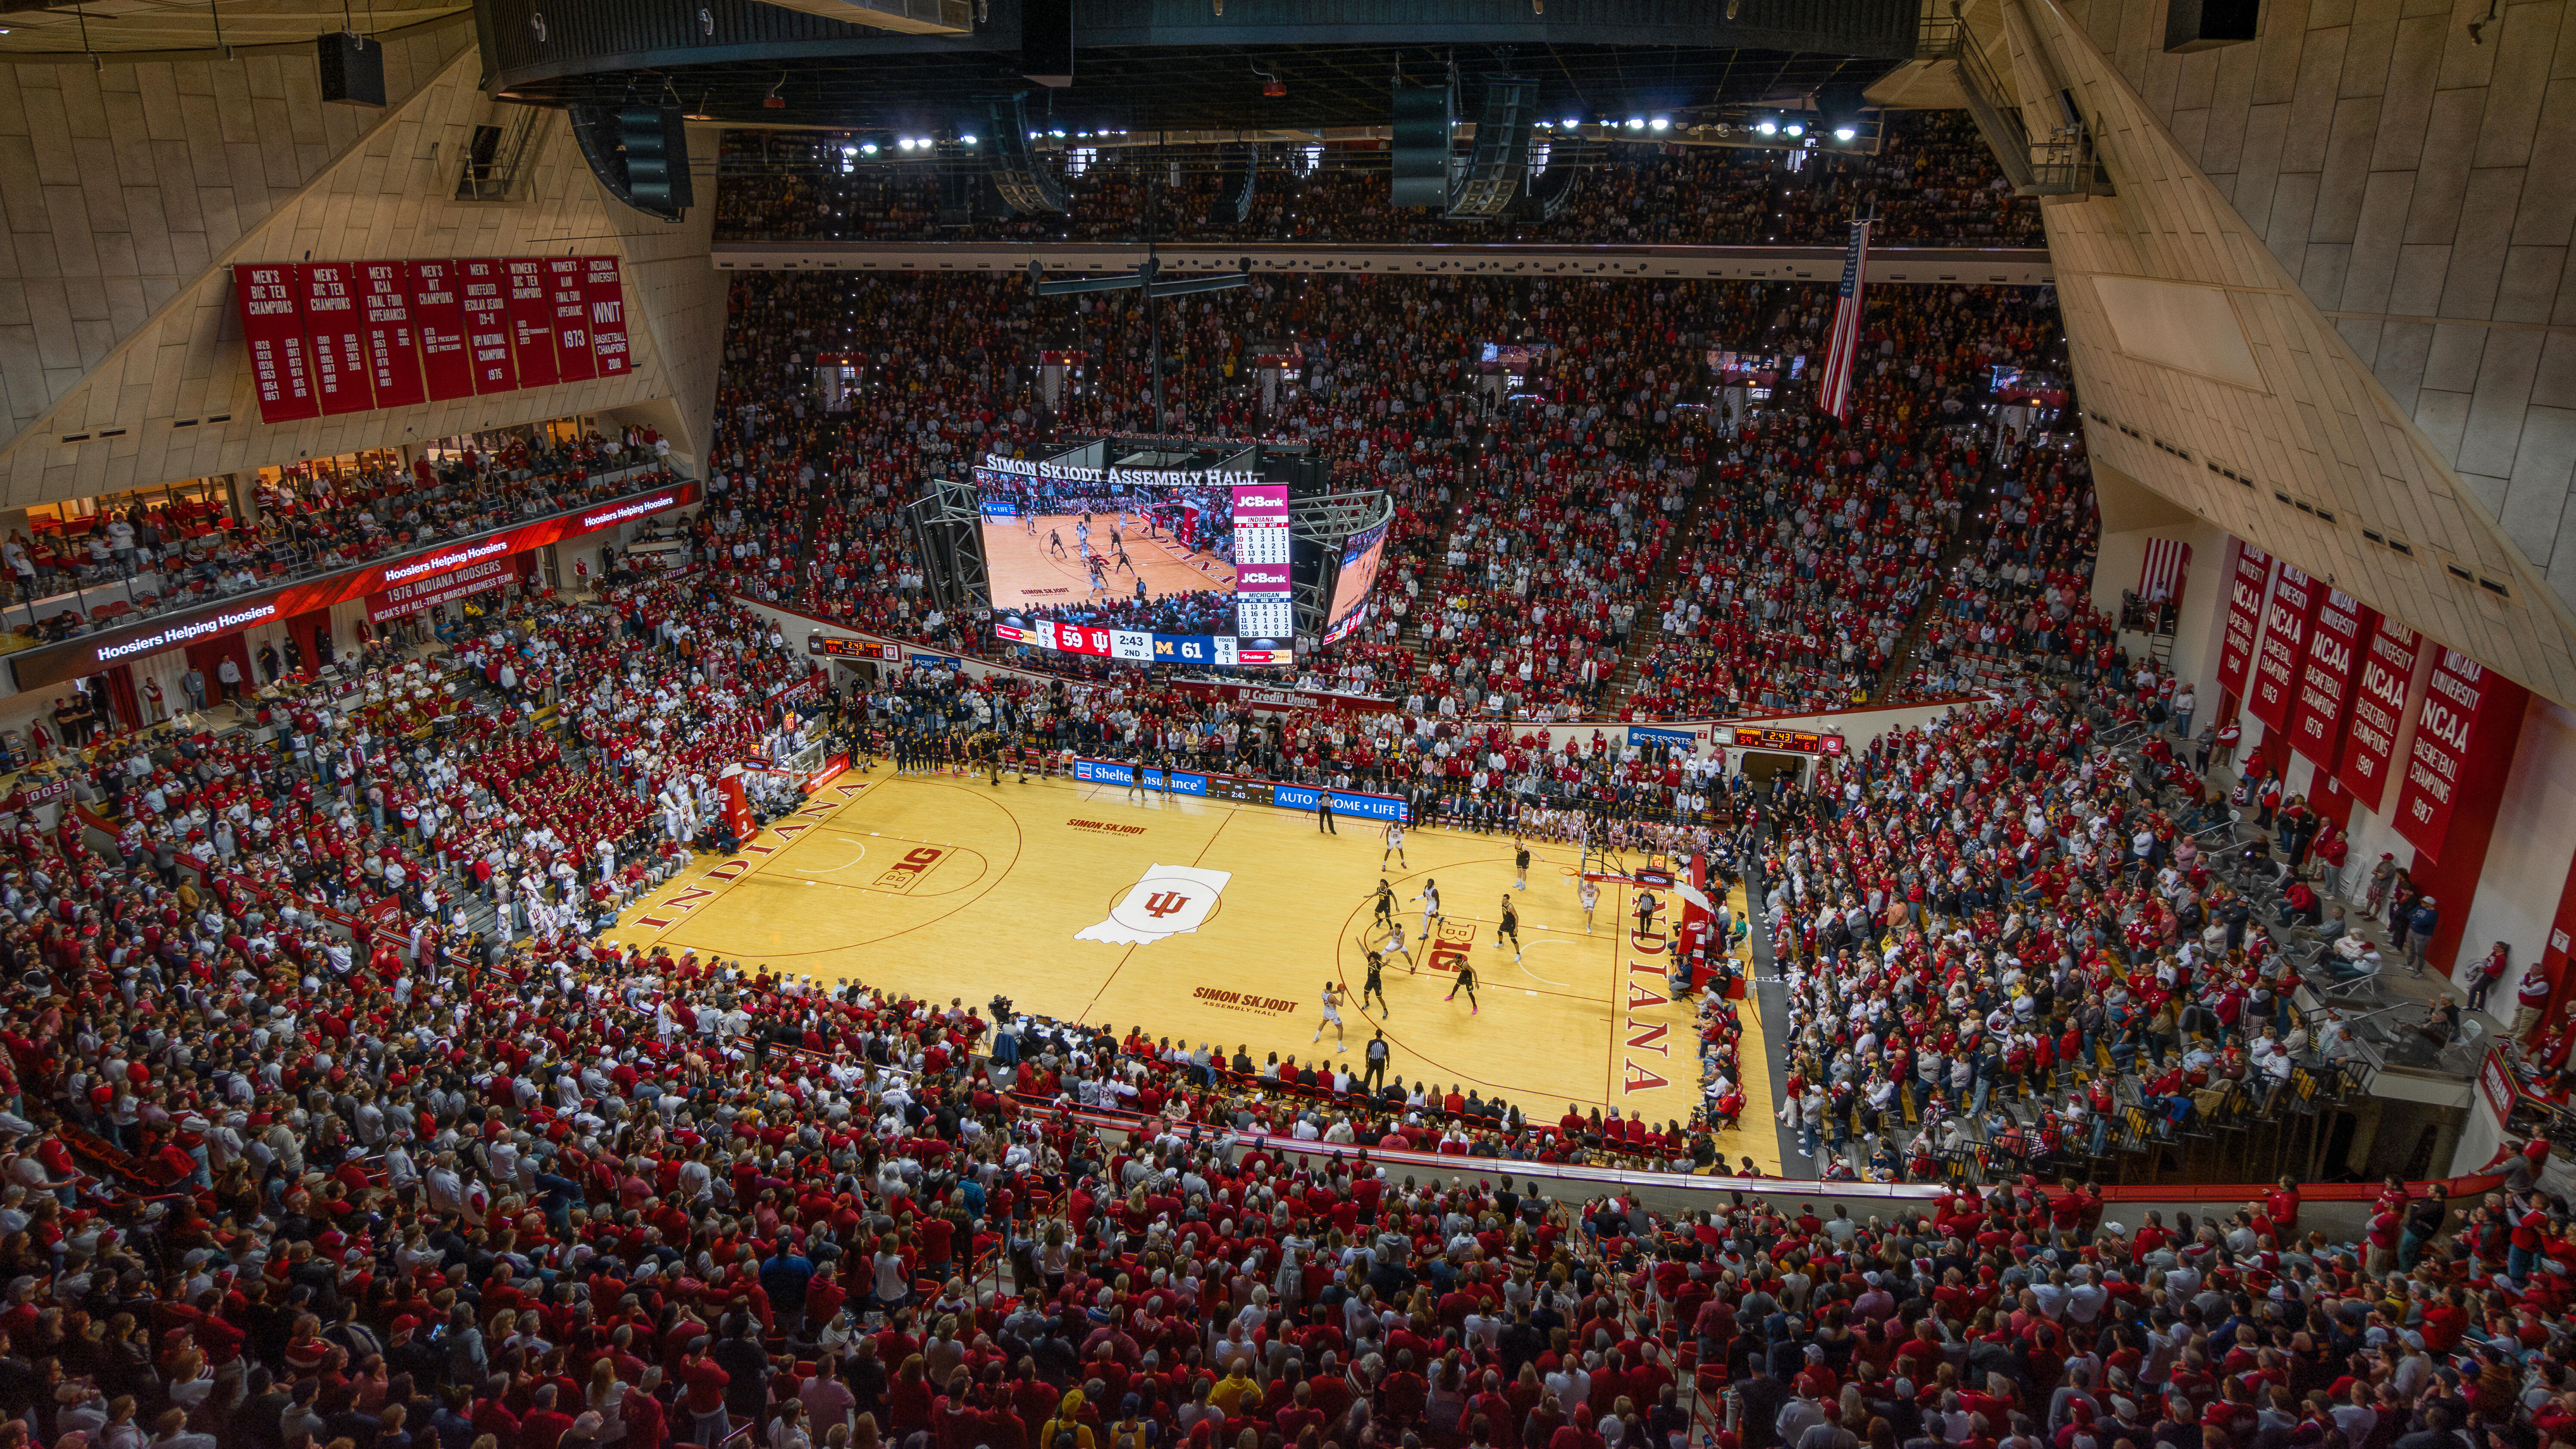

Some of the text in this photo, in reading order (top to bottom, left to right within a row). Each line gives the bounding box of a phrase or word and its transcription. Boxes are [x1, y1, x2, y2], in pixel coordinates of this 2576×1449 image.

[421, 266, 443, 277] MEN'S
[470, 264, 489, 275] MEN'S
[510, 263, 537, 274] WOMEN'S
[552, 261, 577, 272] WOMEN'S
[590, 260, 613, 271] INDIANA
[252, 270, 279, 284] MEN'S
[314, 269, 338, 281] MEN'S
[369, 267, 392, 279] MEN'S
[588, 272, 617, 283] UNIVERSITY
[374, 281, 391, 293] NCAA
[428, 279, 439, 291] NIT
[514, 276, 538, 286] BIG TEN
[561, 276, 572, 287] AIAW
[251, 285, 286, 299] BIG TEN
[313, 283, 344, 295] BIG TEN
[468, 284, 496, 295] UNDEFEATED
[513, 288, 542, 299] CHAMPIONS
[311, 297, 350, 310] CHAMPIONS
[367, 294, 402, 307] FINAL FOUR
[419, 292, 453, 304] CHAMPIONS
[464, 298, 503, 311] REGULAR SEASON
[249, 300, 293, 315] CHAMPIONS
[593, 301, 620, 323] WNIT
[369, 308, 406, 322] APPEARANCES
[474, 334, 505, 346] UPI NATIONAL
[564, 330, 585, 347] 1973
[594, 332, 626, 344] BASKETBALL
[478, 349, 505, 361] CHAMPIONS
[598, 343, 625, 355] CHAMPIONS
[608, 358, 621, 369] 2018
[489, 368, 502, 380] 1975
[1238, 496, 1283, 507] JCBank
[585, 497, 673, 526] Hoosiers Helping Hoosiers
[386, 542, 507, 581] Hoosiers Helping Hoosiers
[663, 567, 687, 579] NATION
[1241, 573, 1286, 583] JCBank
[387, 560, 501, 602] 1976 INDIANA HOOSIERS
[374, 573, 513, 621] NCAA'S #1 ALL-TIME MARCH MADNESS TEAM
[2232, 580, 2259, 616] NCAA
[2268, 603, 2302, 644] NCAA
[2320, 605, 2358, 639] UNIVERSITY
[98, 606, 275, 660] Hoosiers Helping Hoosiers
[1063, 631, 1082, 647] 59
[1120, 635, 1143, 646] 2:43
[1155, 641, 1202, 658] M 61
[2310, 631, 2350, 675] NCAA
[2372, 634, 2415, 672] UNIVERSITY
[2443, 648, 2482, 684] INDIANA
[2305, 664, 2341, 701] BASKETBALL
[2362, 660, 2405, 711] NCAA
[2261, 682, 2278, 704] 1953
[2431, 669, 2481, 711] UNIVERSITY
[1252, 690, 1285, 703] Credit
[1287, 693, 1317, 706] Union
[2301, 685, 2337, 720] CHAMPIONS
[2356, 697, 2395, 737] BASKETBALL
[2305, 715, 2324, 739] 1976
[2419, 698, 2470, 754] NCAA
[1770, 732, 1790, 741] 2:43
[2353, 719, 2390, 757] CHAMPIONS
[2356, 752, 2374, 778] 1981
[2413, 736, 2458, 782] BASKETBALL
[2410, 761, 2451, 804] CHAMPIONS
[1279, 792, 1313, 804] AUTO
[1373, 804, 1395, 815] LIFE
[2412, 796, 2434, 824] 1987
[1067, 819, 1147, 835] SIMON SKJODT
[630, 781, 873, 931] INDIANA
[1193, 986, 1298, 1013] SIMON SKJODT
[1203, 1001, 1252, 1013] ASSEMBLY
